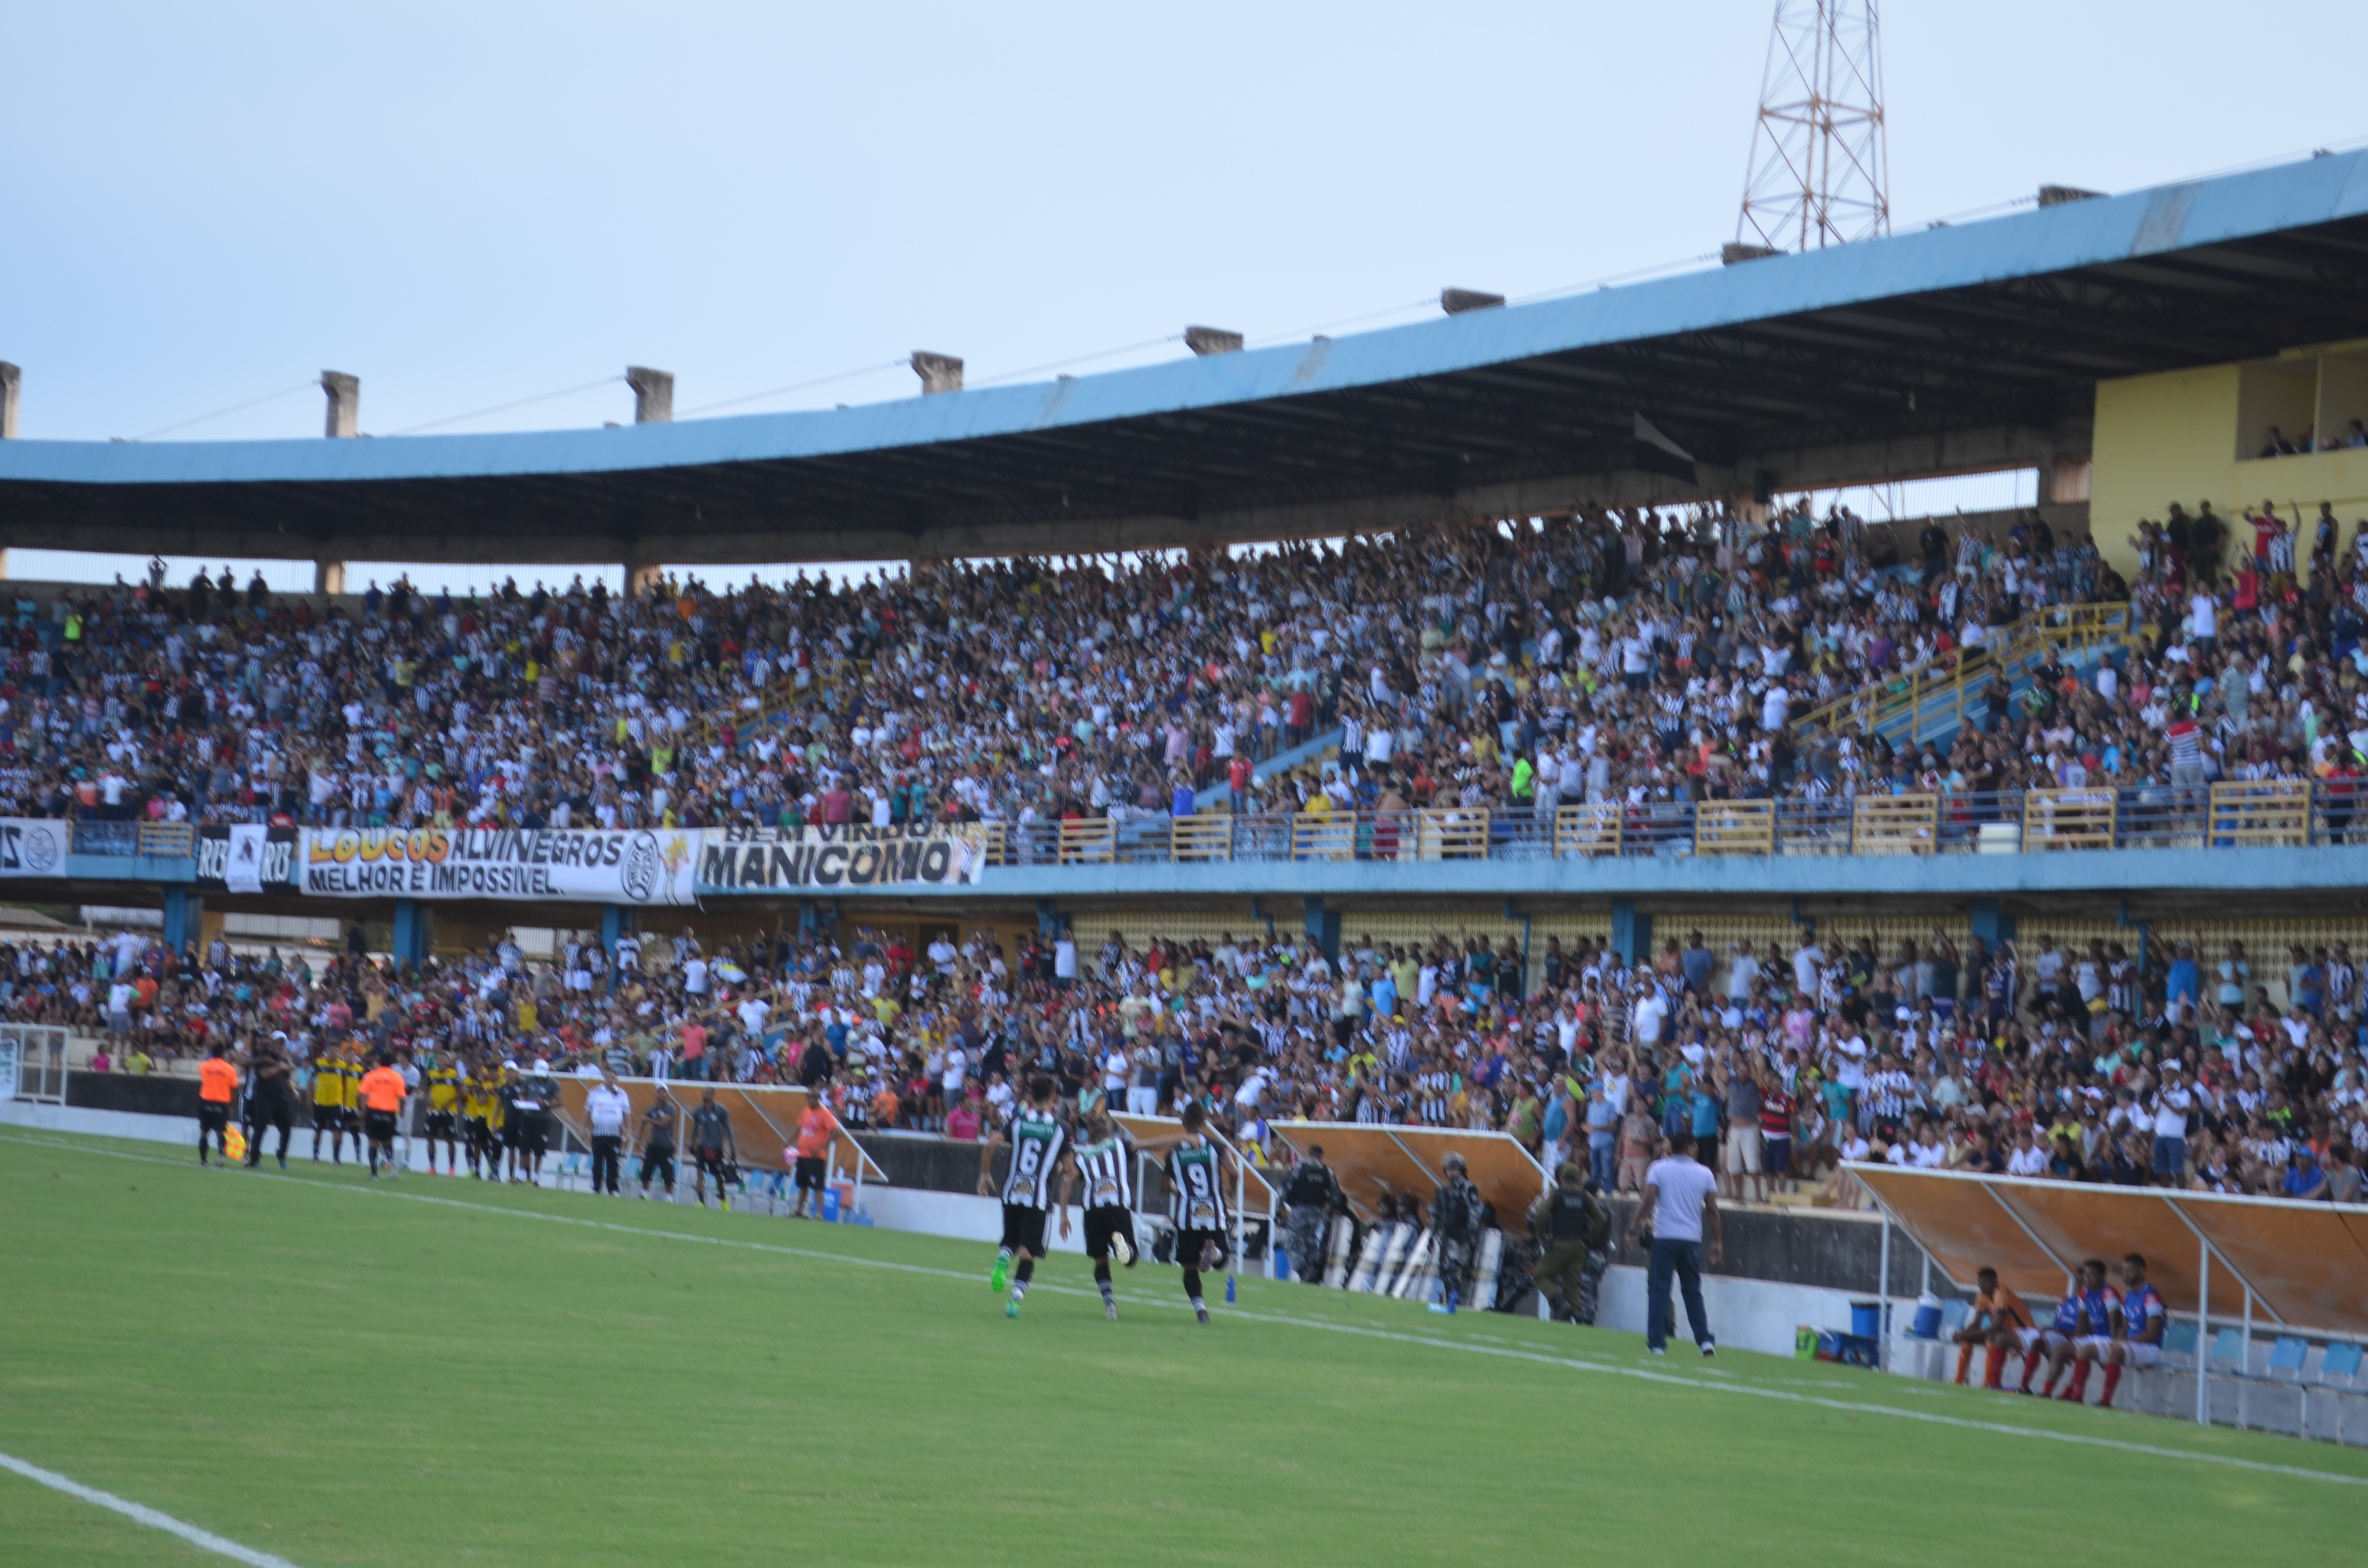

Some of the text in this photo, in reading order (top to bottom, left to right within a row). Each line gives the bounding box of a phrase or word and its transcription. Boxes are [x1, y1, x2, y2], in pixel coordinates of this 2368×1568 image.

[309, 827, 625, 867] LOUCOS ALVINEGROS
[308, 866, 404, 893] MELHOR
[1019, 1138, 1042, 1175] 6
[1187, 1163, 1209, 1199] 9
